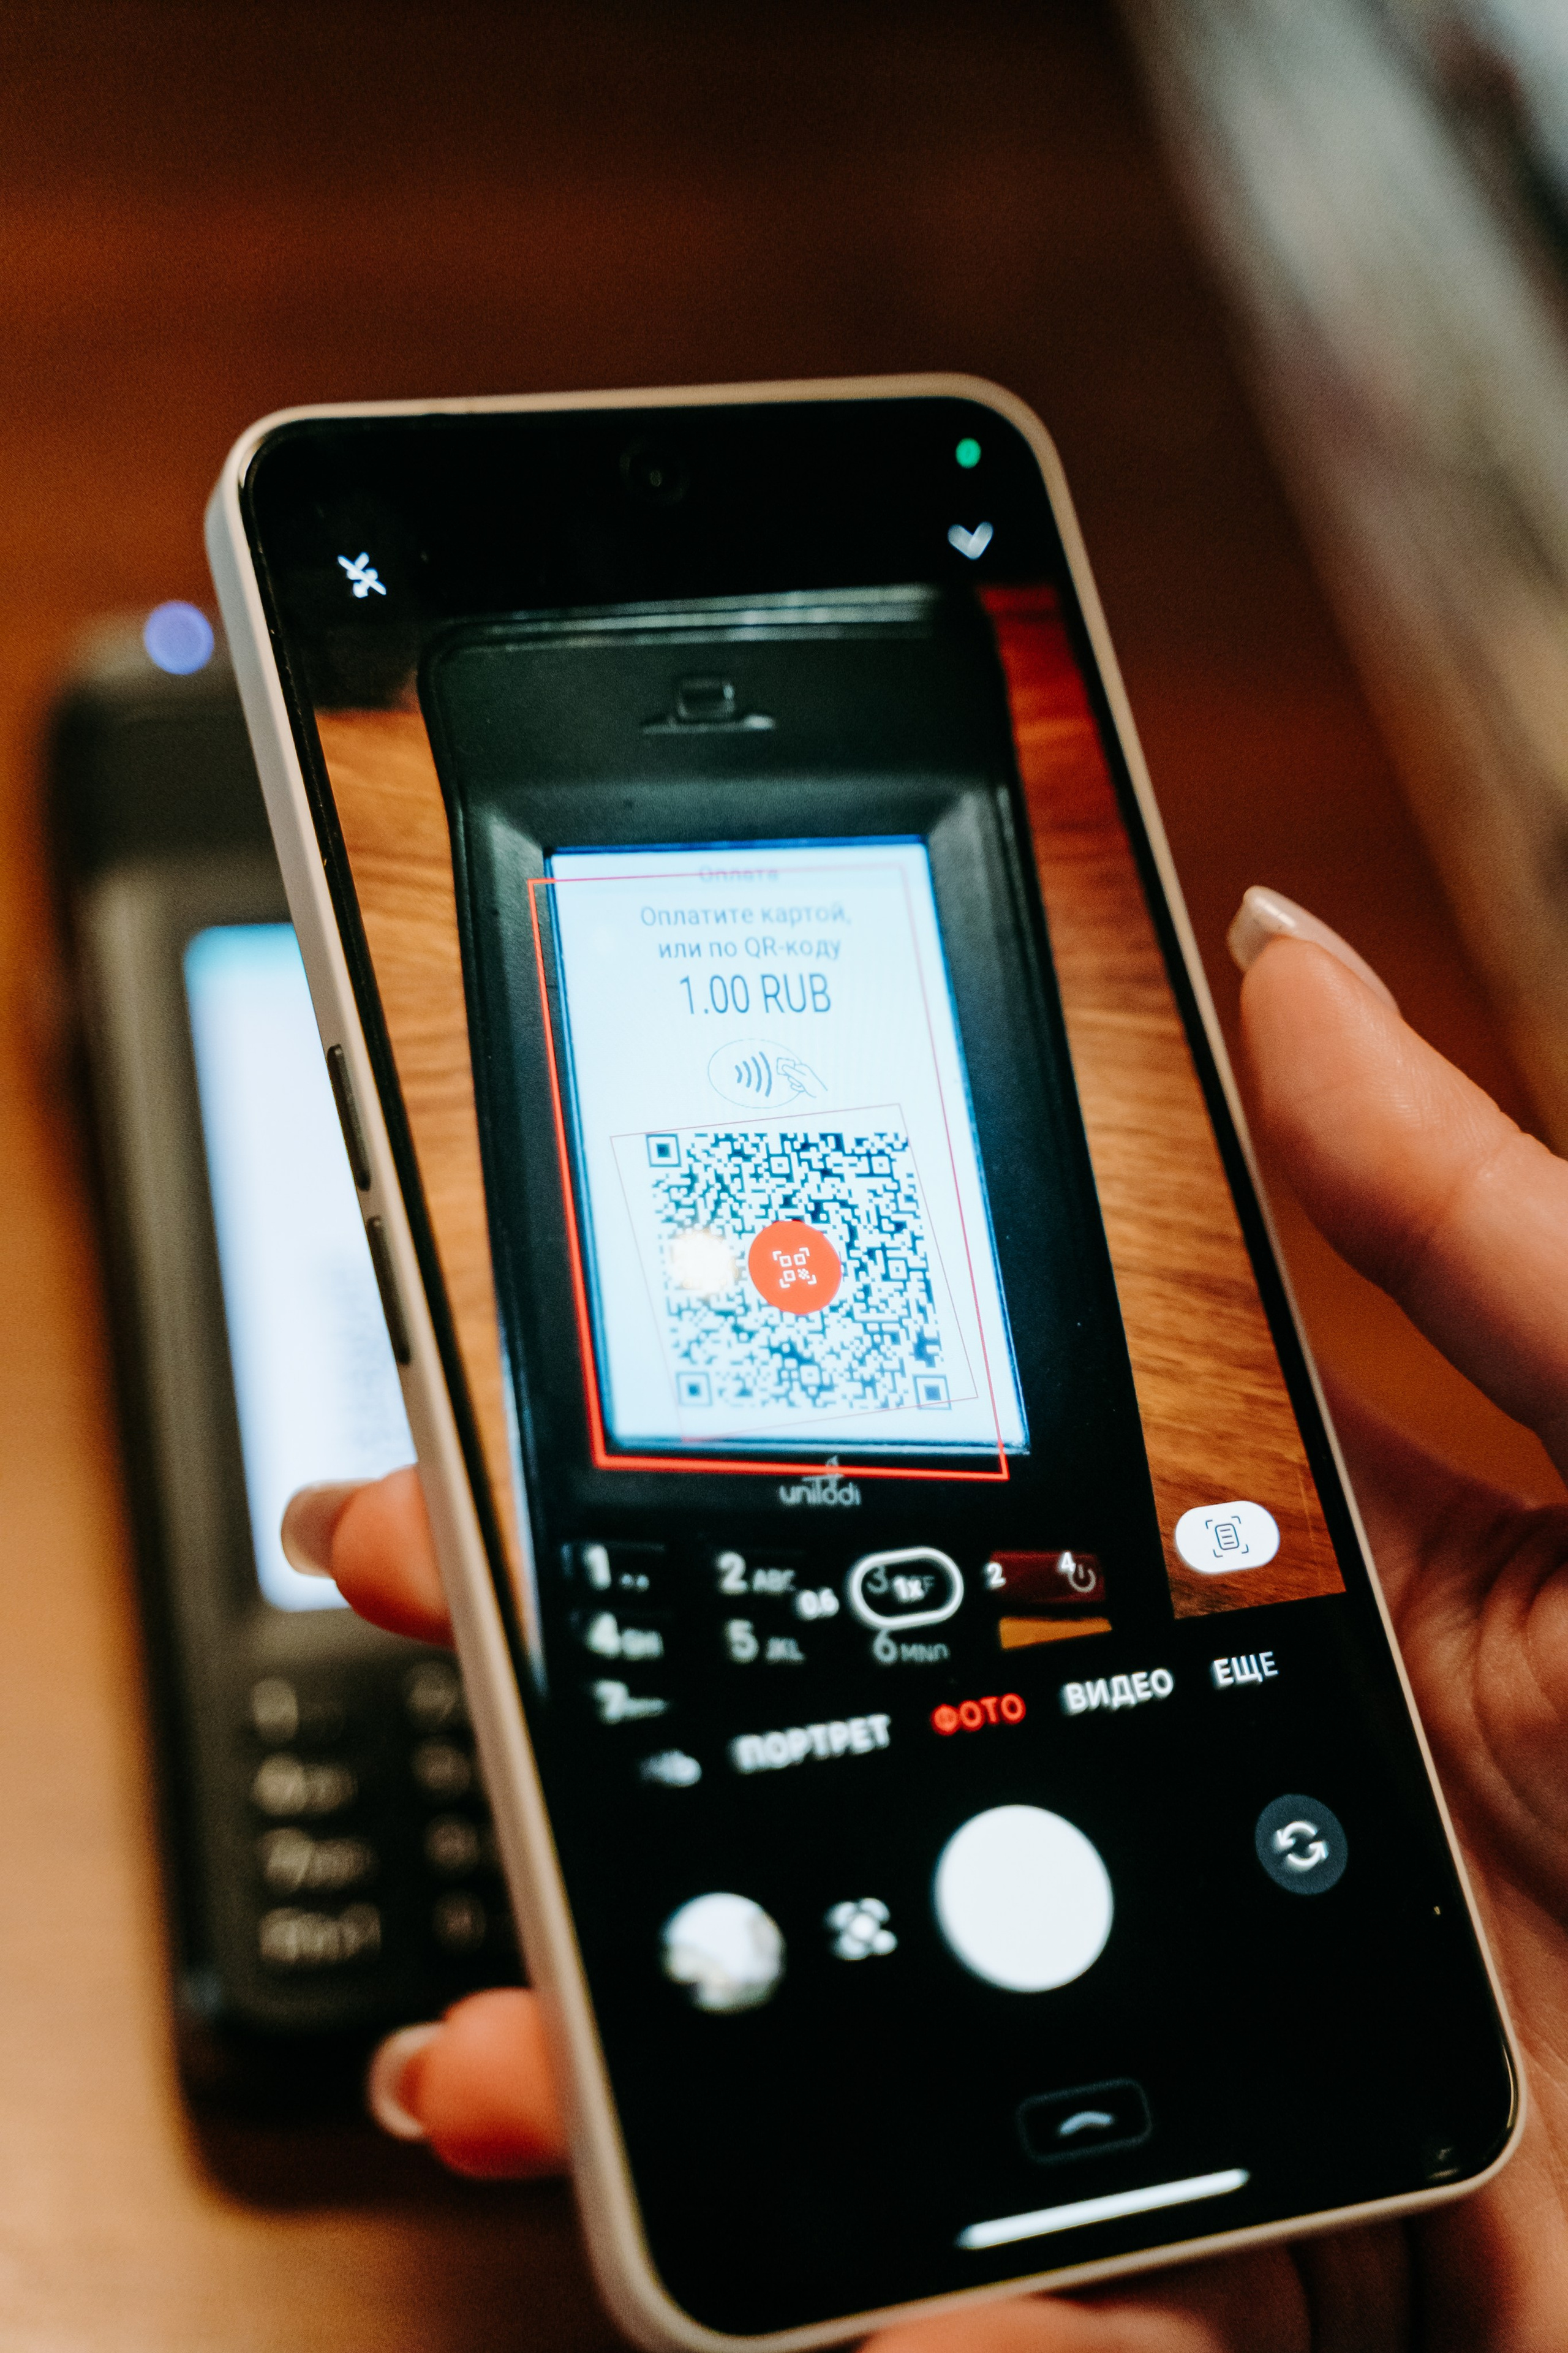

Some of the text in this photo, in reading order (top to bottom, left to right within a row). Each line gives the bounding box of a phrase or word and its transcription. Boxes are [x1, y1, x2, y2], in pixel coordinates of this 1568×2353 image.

[641, 901, 852, 929] Оплатите картой,
[659, 935, 842, 960] или по QR-коду
[679, 972, 832, 1014] 1.00 RUB
[717, 1551, 748, 1594] 2
[984, 1562, 1006, 1590] 2
[1057, 1550, 1076, 1574] 4
[727, 1619, 760, 1663] 5
[873, 1628, 899, 1666] 6
[733, 1714, 891, 1772] ПОРТРЕТ
[931, 1693, 1027, 1735] ФОТО
[1063, 1668, 1175, 1714] ВИДЕО
[1212, 1651, 1279, 1689] ЕЩЕ
